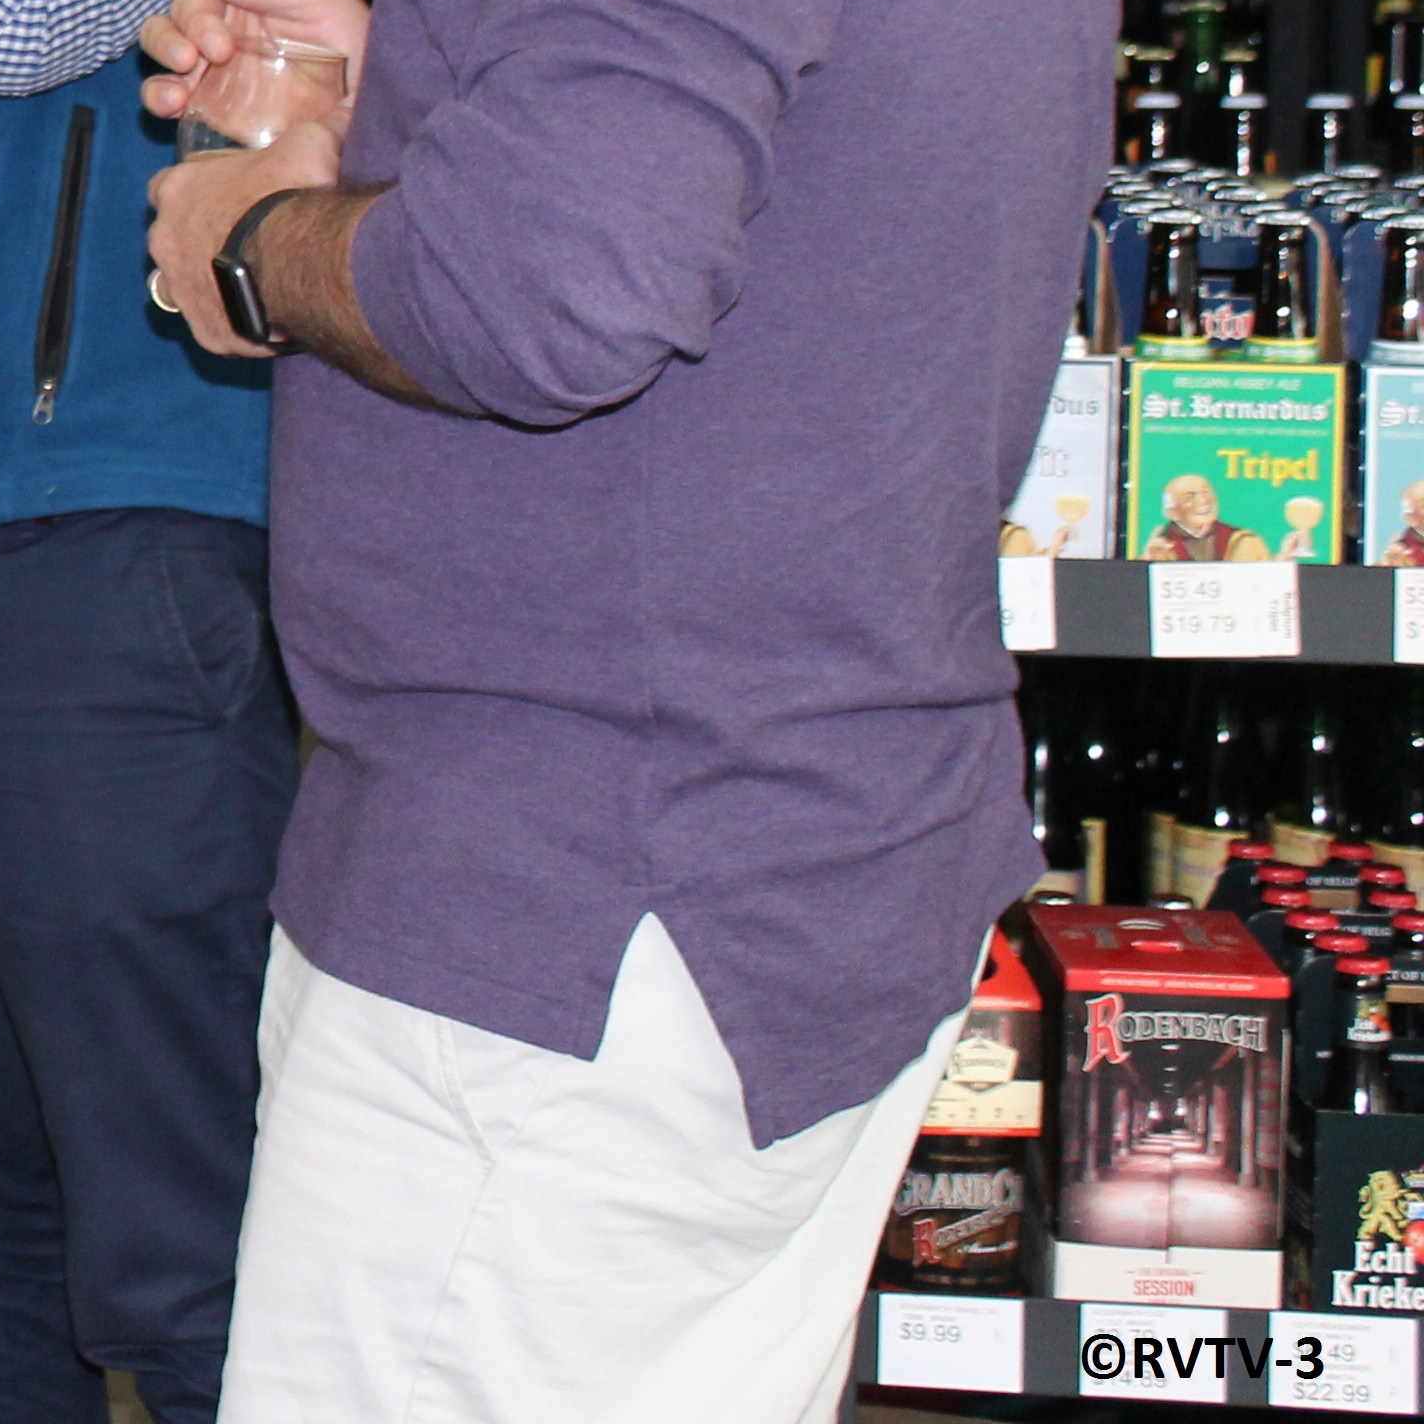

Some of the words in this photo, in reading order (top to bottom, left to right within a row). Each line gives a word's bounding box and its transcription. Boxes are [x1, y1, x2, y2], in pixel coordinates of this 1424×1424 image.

[1141, 391, 1189, 420] St.
[1189, 392, 1330, 422] Bernardus
[1216, 448, 1320, 488] Tripel
[1082, 992, 1269, 1073] RODENBACH
[1354, 1240, 1418, 1275] Echt
[1133, 1278, 1196, 1297] SESSION
[899, 1321, 961, 1343] $9.99
[1291, 1380, 1370, 1404] $22.99
